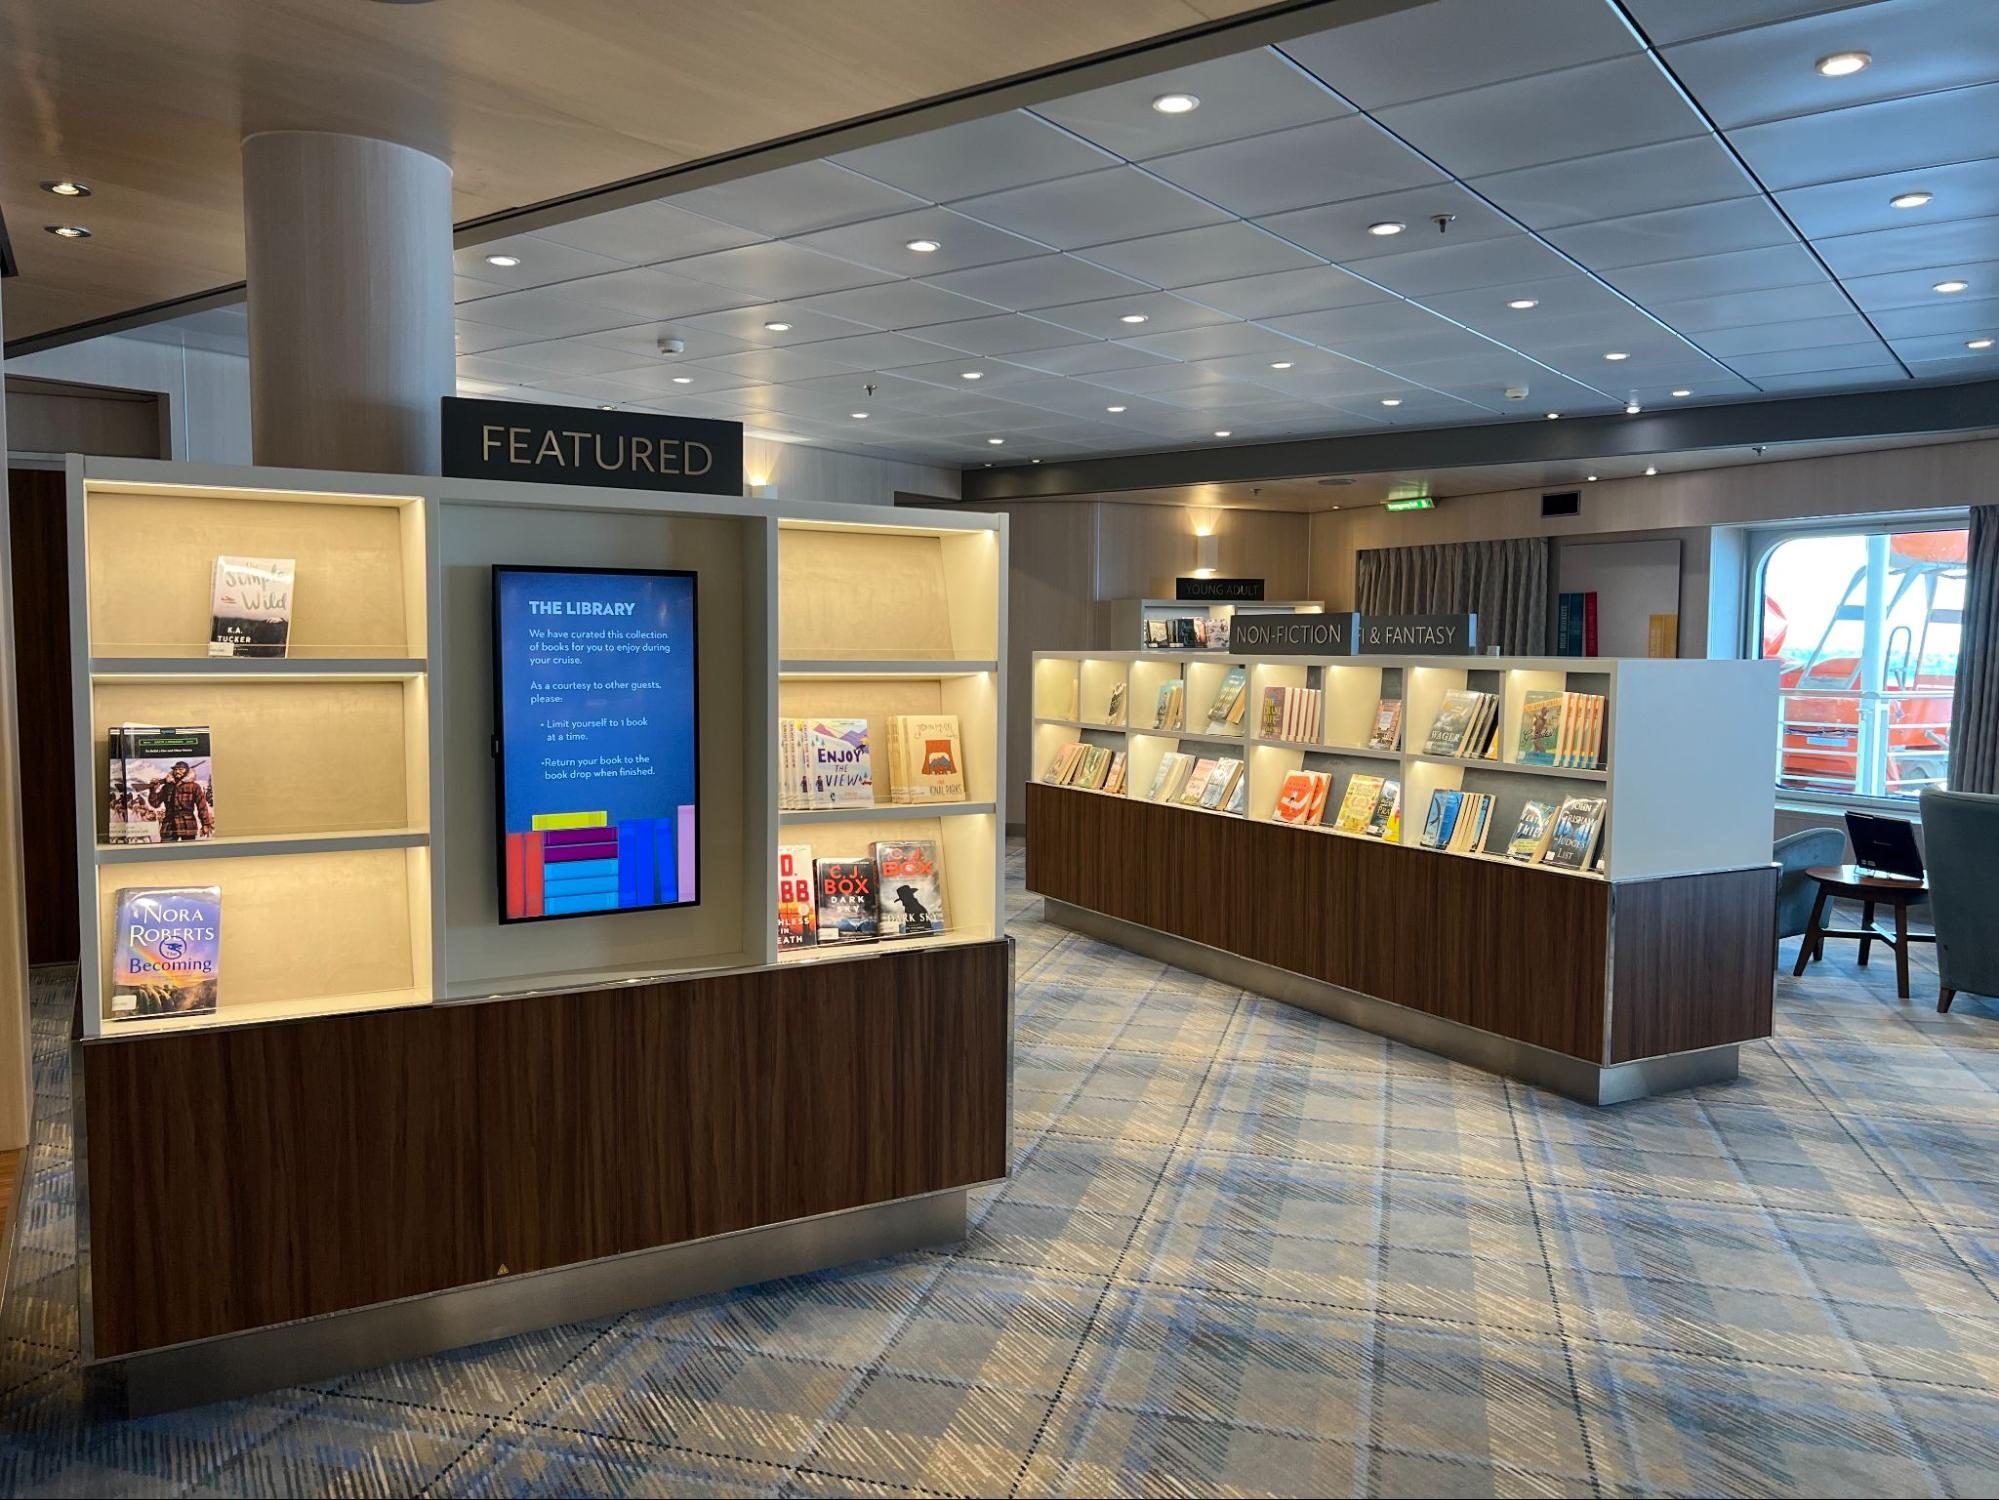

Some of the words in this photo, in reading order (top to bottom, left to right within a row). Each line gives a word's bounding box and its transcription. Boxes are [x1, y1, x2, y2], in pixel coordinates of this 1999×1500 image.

[482, 424, 713, 477] FEATURED
[1186, 583, 1224, 596] YOUNG
[1226, 583, 1260, 596] ADULT
[241, 591, 288, 610] Wild
[529, 601, 562, 615] THE
[566, 601, 635, 616] LIBRARY
[217, 635, 251, 644] TUCKER
[529, 629, 545, 639] We
[547, 629, 568, 639] have
[571, 630, 605, 639] curated
[607, 630, 623, 639] this
[625, 630, 668, 639] collection
[1236, 624, 1341, 644] NON-FICTION
[1370, 626, 1381, 645] &
[1386, 626, 1456, 645] FANTASY
[529, 642, 539, 651] of
[542, 642, 569, 651] books
[571, 642, 584, 651] for
[587, 644, 602, 653] you
[605, 643, 614, 652] to
[617, 643, 641, 653] enjoy
[642, 643, 671, 653] during
[530, 657, 550, 666] your
[553, 656, 583, 665] cruise.
[530, 681, 542, 690] As
[552, 681, 591, 692] courtesy
[593, 681, 602, 690] to
[605, 680, 628, 690] other
[530, 694, 563, 705] please:
[546, 720, 569, 729] Limit
[571, 718, 607, 729] yourself
[609, 719, 618, 727] to
[620, 719, 624, 727] 1
[626, 717, 648, 727] book
[546, 733, 555, 741] at
[566, 732, 588, 741] time.
[578, 758, 597, 767] your
[600, 755, 622, 765] book
[624, 756, 633, 764] to
[635, 755, 650, 763] the
[817, 748, 862, 763] ENJOY
[544, 770, 567, 779] book
[570, 769, 591, 779] drop
[594, 768, 617, 777] when
[620, 766, 655, 776] finished.
[834, 764, 849, 773] THE
[825, 774, 858, 787] VIEW
[1571, 801, 1592, 811] JOHN
[1557, 848, 1574, 860] LIST
[780, 854, 798, 877] D.
[882, 860, 932, 878] BOX
[780, 880, 810, 903] BB
[824, 879, 870, 896] BOX
[830, 896, 865, 904] DARK
[143, 904, 204, 924] NORA
[887, 912, 916, 922] DARK
[919, 911, 938, 922] SKY
[777, 917, 810, 926] HLESS
[129, 924, 215, 947] ROBERTS
[777, 935, 803, 945] EATH
[129, 957, 212, 974] Becoming
